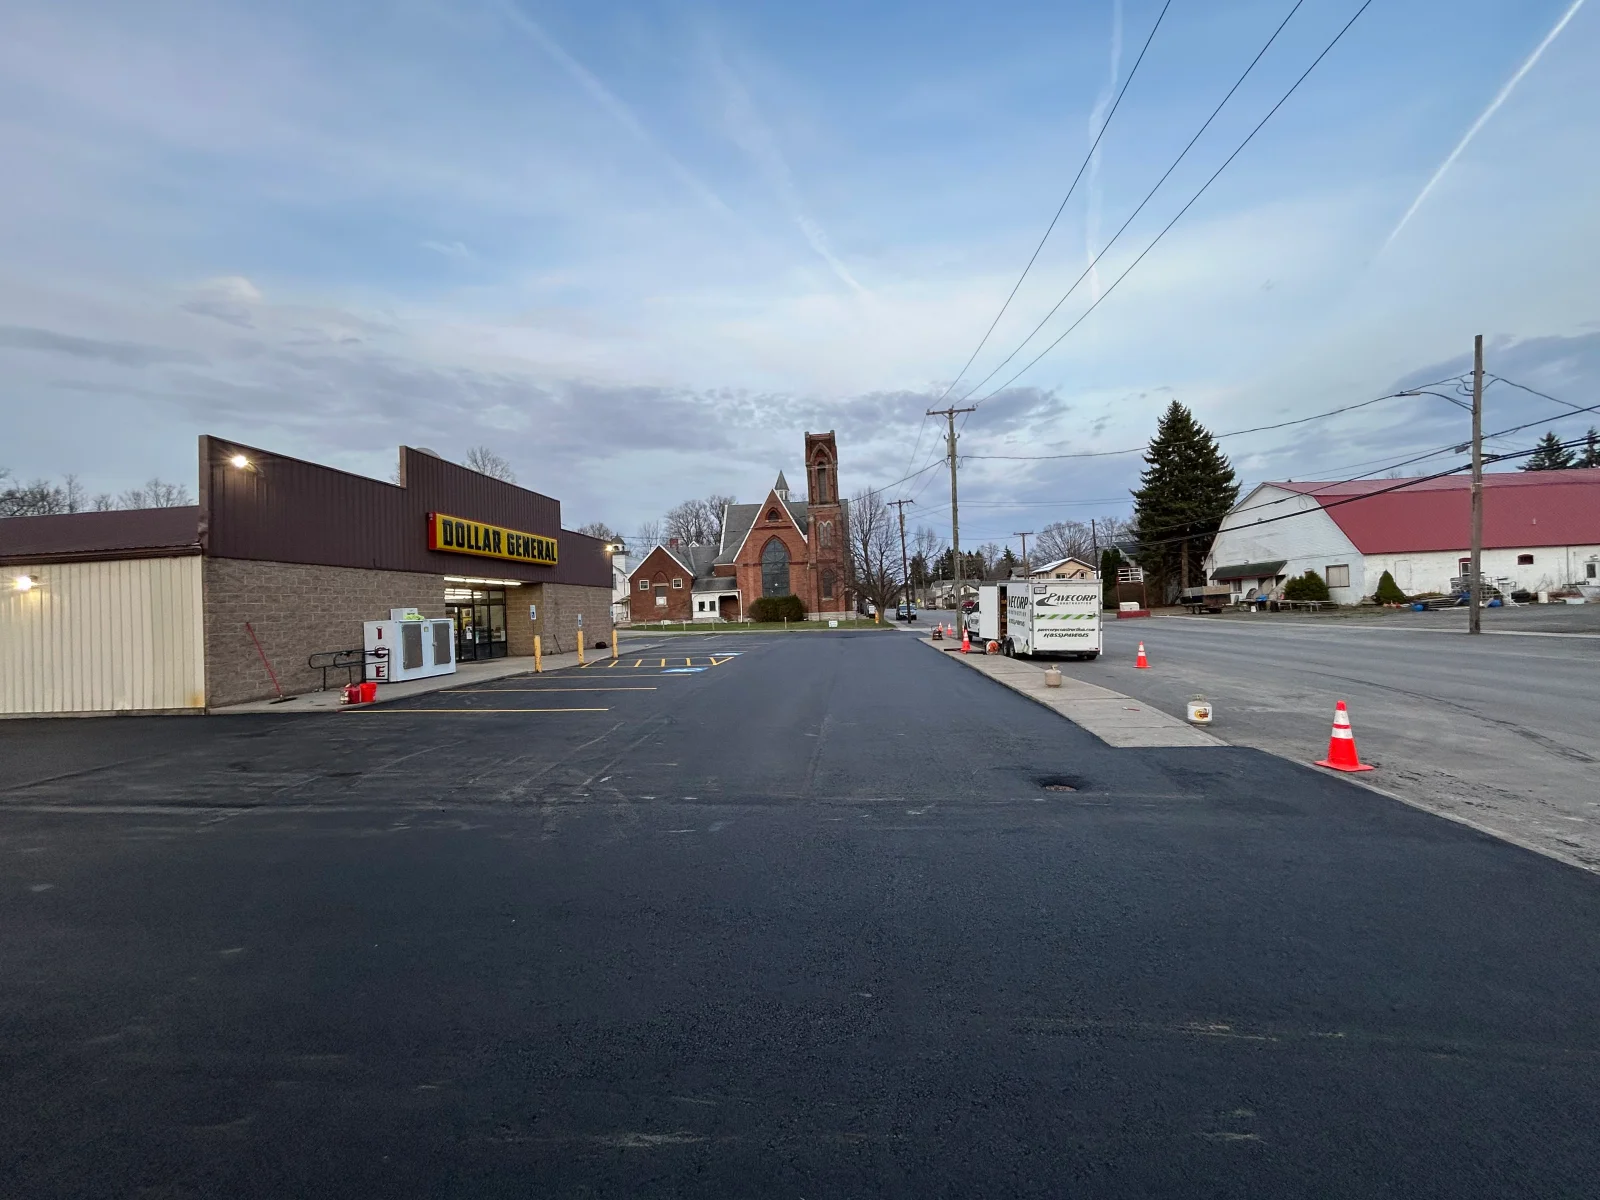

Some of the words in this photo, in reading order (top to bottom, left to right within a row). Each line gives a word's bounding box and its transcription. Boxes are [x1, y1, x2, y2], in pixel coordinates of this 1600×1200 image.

[442, 519, 502, 554] DOLLAR
[507, 532, 557, 562] GENERAL
[1046, 593, 1097, 603] PAVECORP
